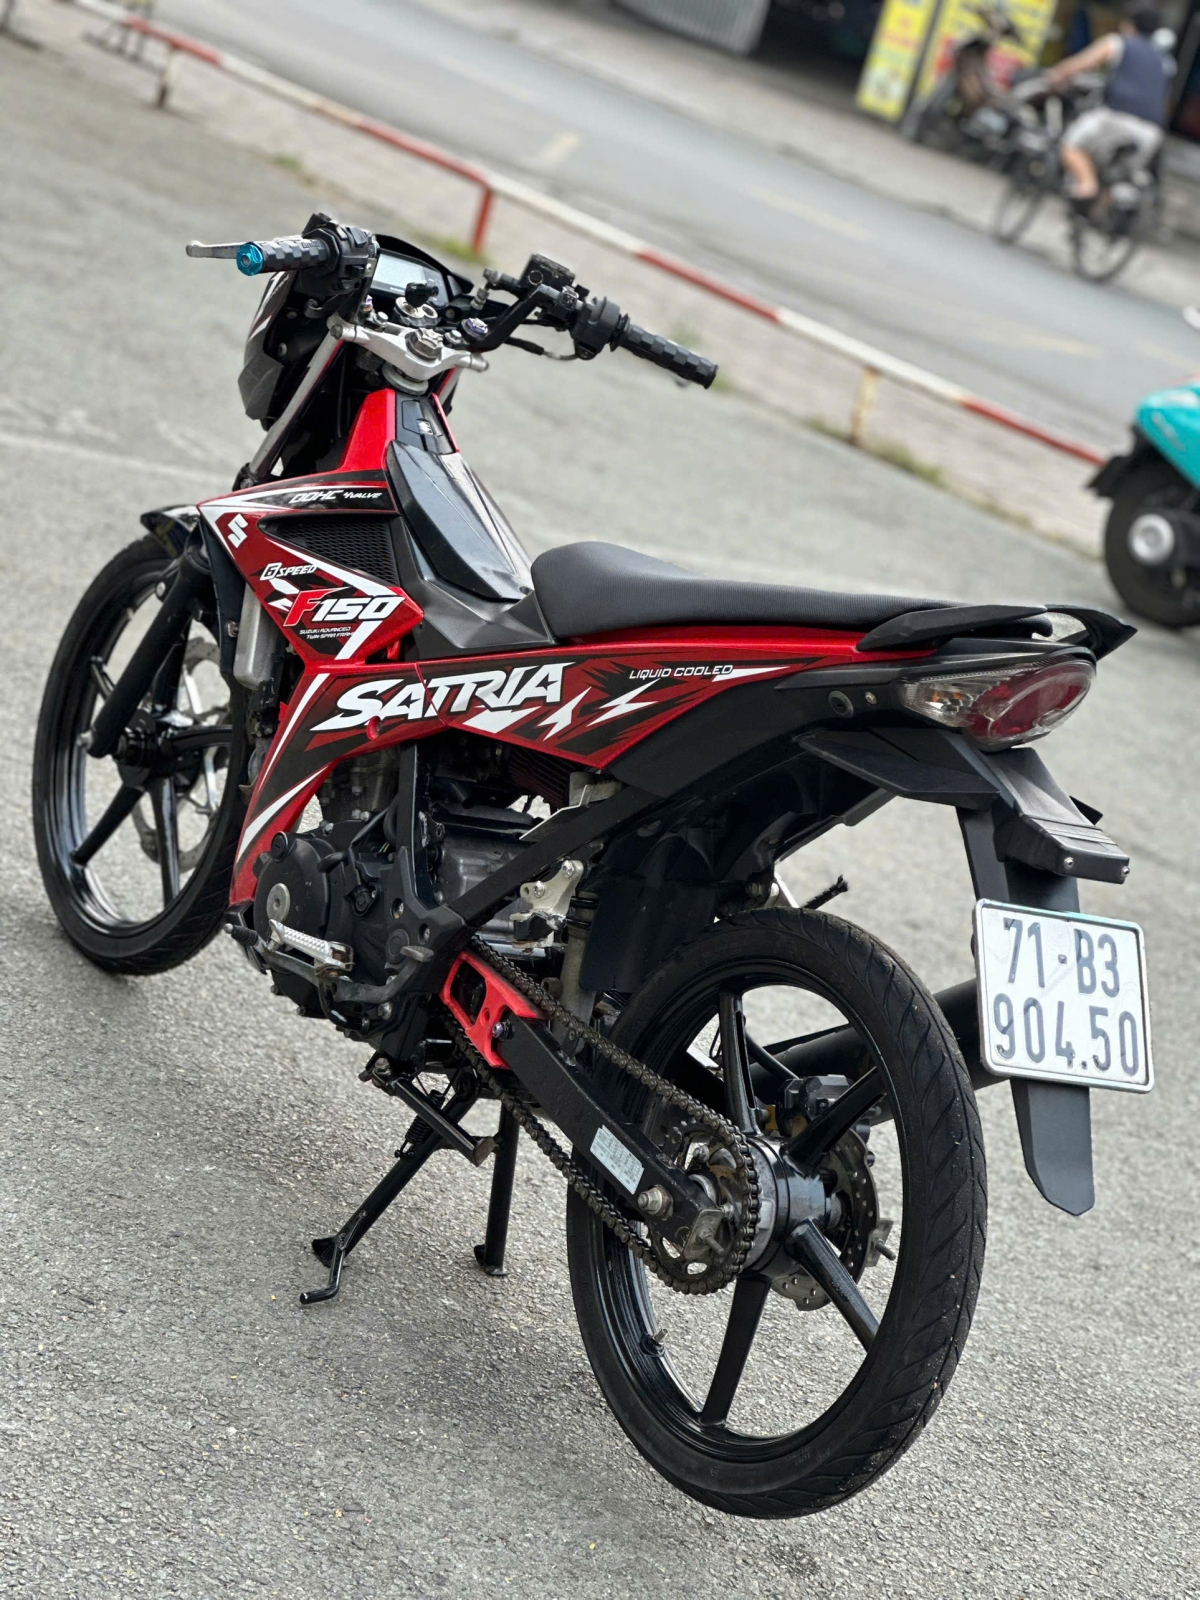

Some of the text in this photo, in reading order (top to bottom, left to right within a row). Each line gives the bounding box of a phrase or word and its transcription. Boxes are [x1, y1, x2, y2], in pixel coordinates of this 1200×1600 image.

[289, 490, 344, 503] DOHC
[283, 586, 406, 627] F150
[629, 665, 733, 680] LIQUID COOLED
[310, 662, 575, 731] SATRIA
[993, 993, 1139, 1076] 904.50
